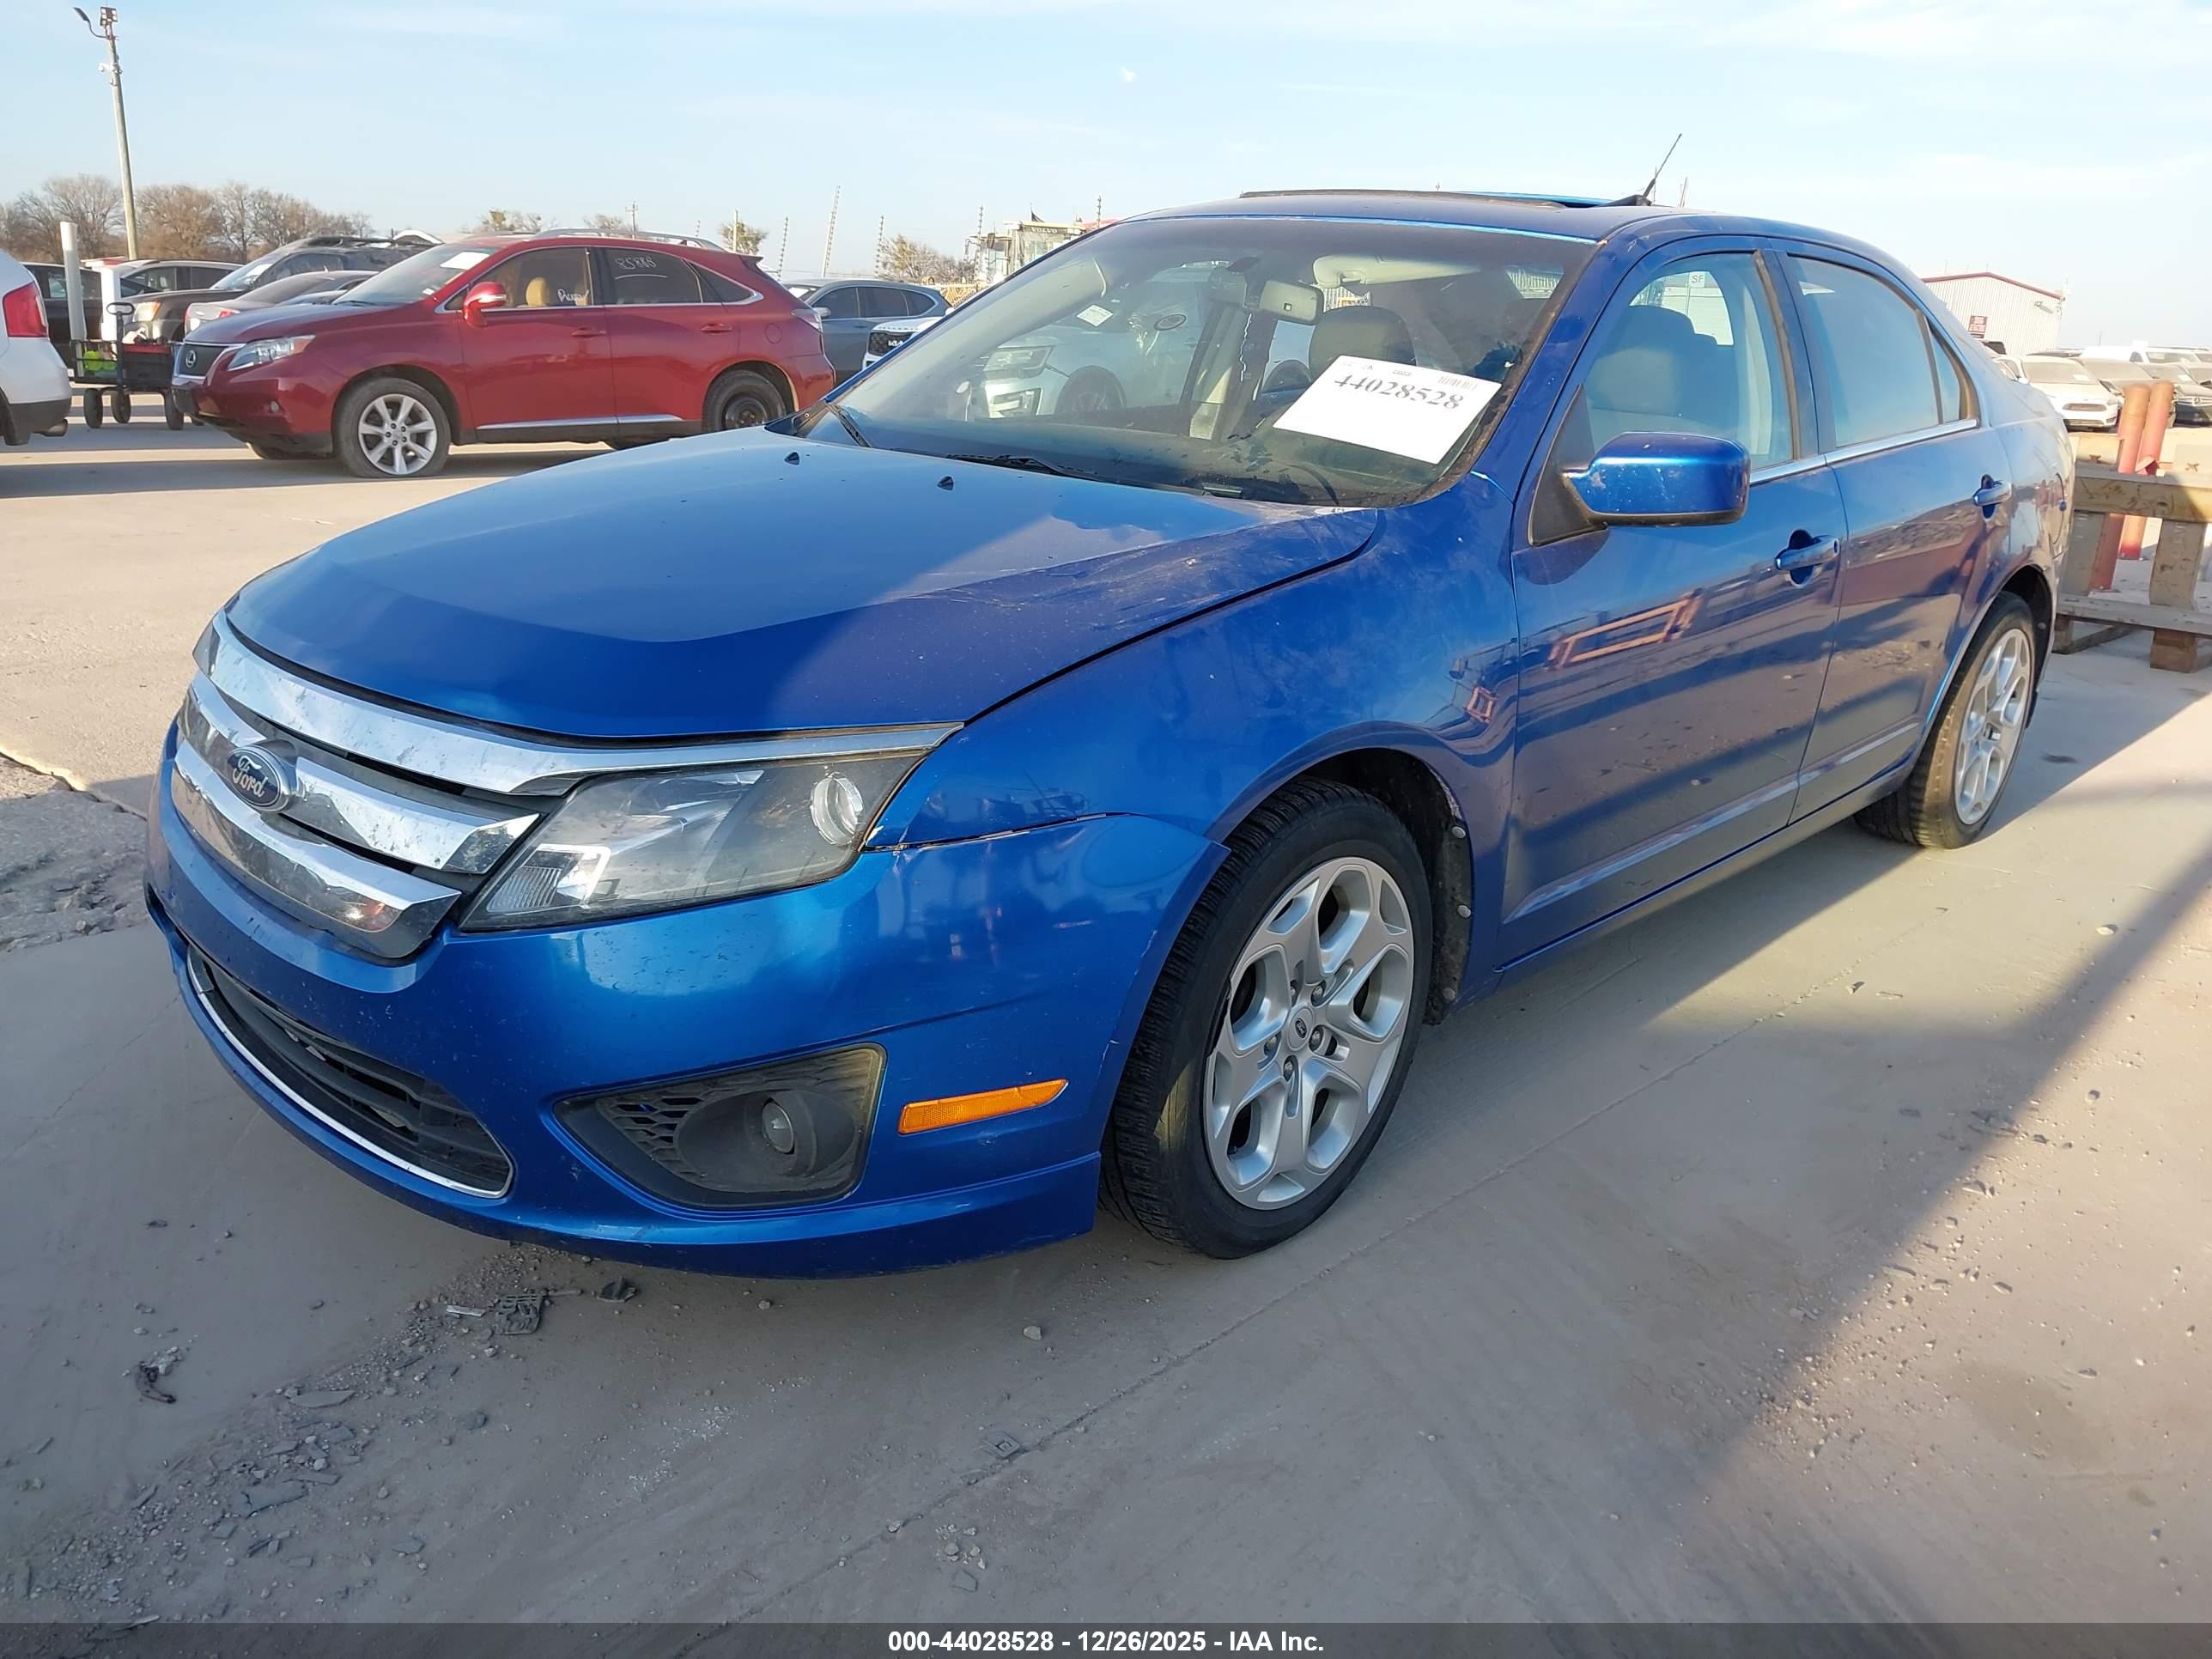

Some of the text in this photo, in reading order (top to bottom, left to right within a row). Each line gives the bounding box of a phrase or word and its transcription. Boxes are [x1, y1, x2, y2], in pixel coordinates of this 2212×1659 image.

[1692, 275, 1705, 283] SF
[1334, 374, 1463, 409] 44028528
[232, 755, 269, 798] Ford
